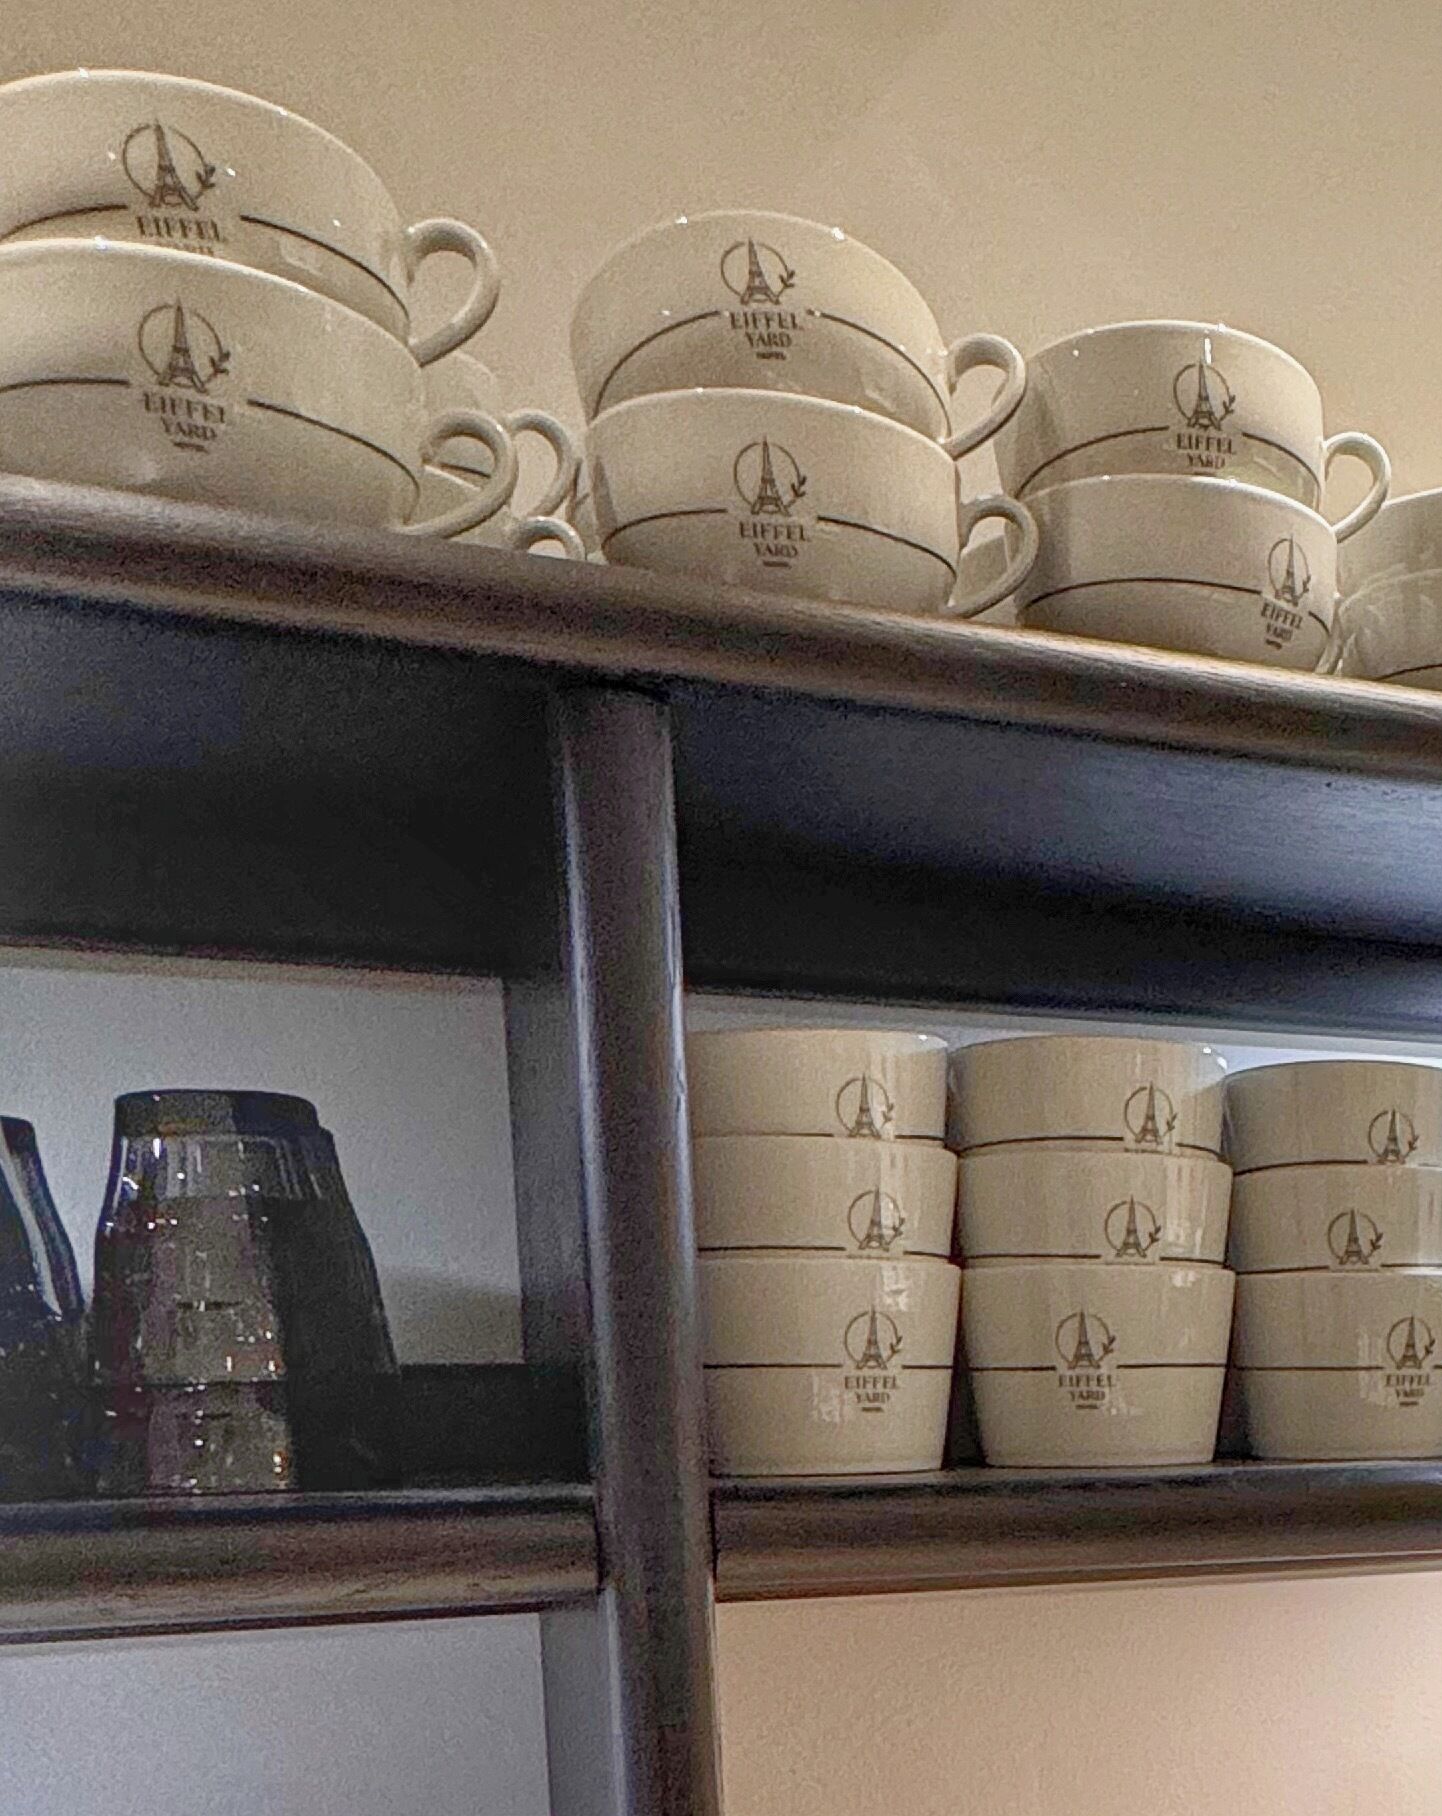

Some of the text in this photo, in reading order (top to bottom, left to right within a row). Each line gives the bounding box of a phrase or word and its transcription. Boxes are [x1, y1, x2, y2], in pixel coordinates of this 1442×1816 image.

[136, 216, 227, 243] EIFFEL
[729, 311, 804, 331] EIFFEL
[744, 331, 792, 348] YARD
[143, 391, 225, 424] EIFFEL
[160, 416, 217, 441] YARD
[1177, 432, 1237, 455] EIFFEL
[1187, 452, 1226, 469] YARD
[740, 521, 811, 542] EIFFEL
[753, 542, 799, 558] YARD
[1260, 601, 1303, 631] EIFFEL
[844, 1374, 900, 1390] EIFFEL
[1059, 1374, 1117, 1388] EIFFEL
[1385, 1374, 1433, 1388] EIFFEL
[854, 1391, 891, 1404] YARD
